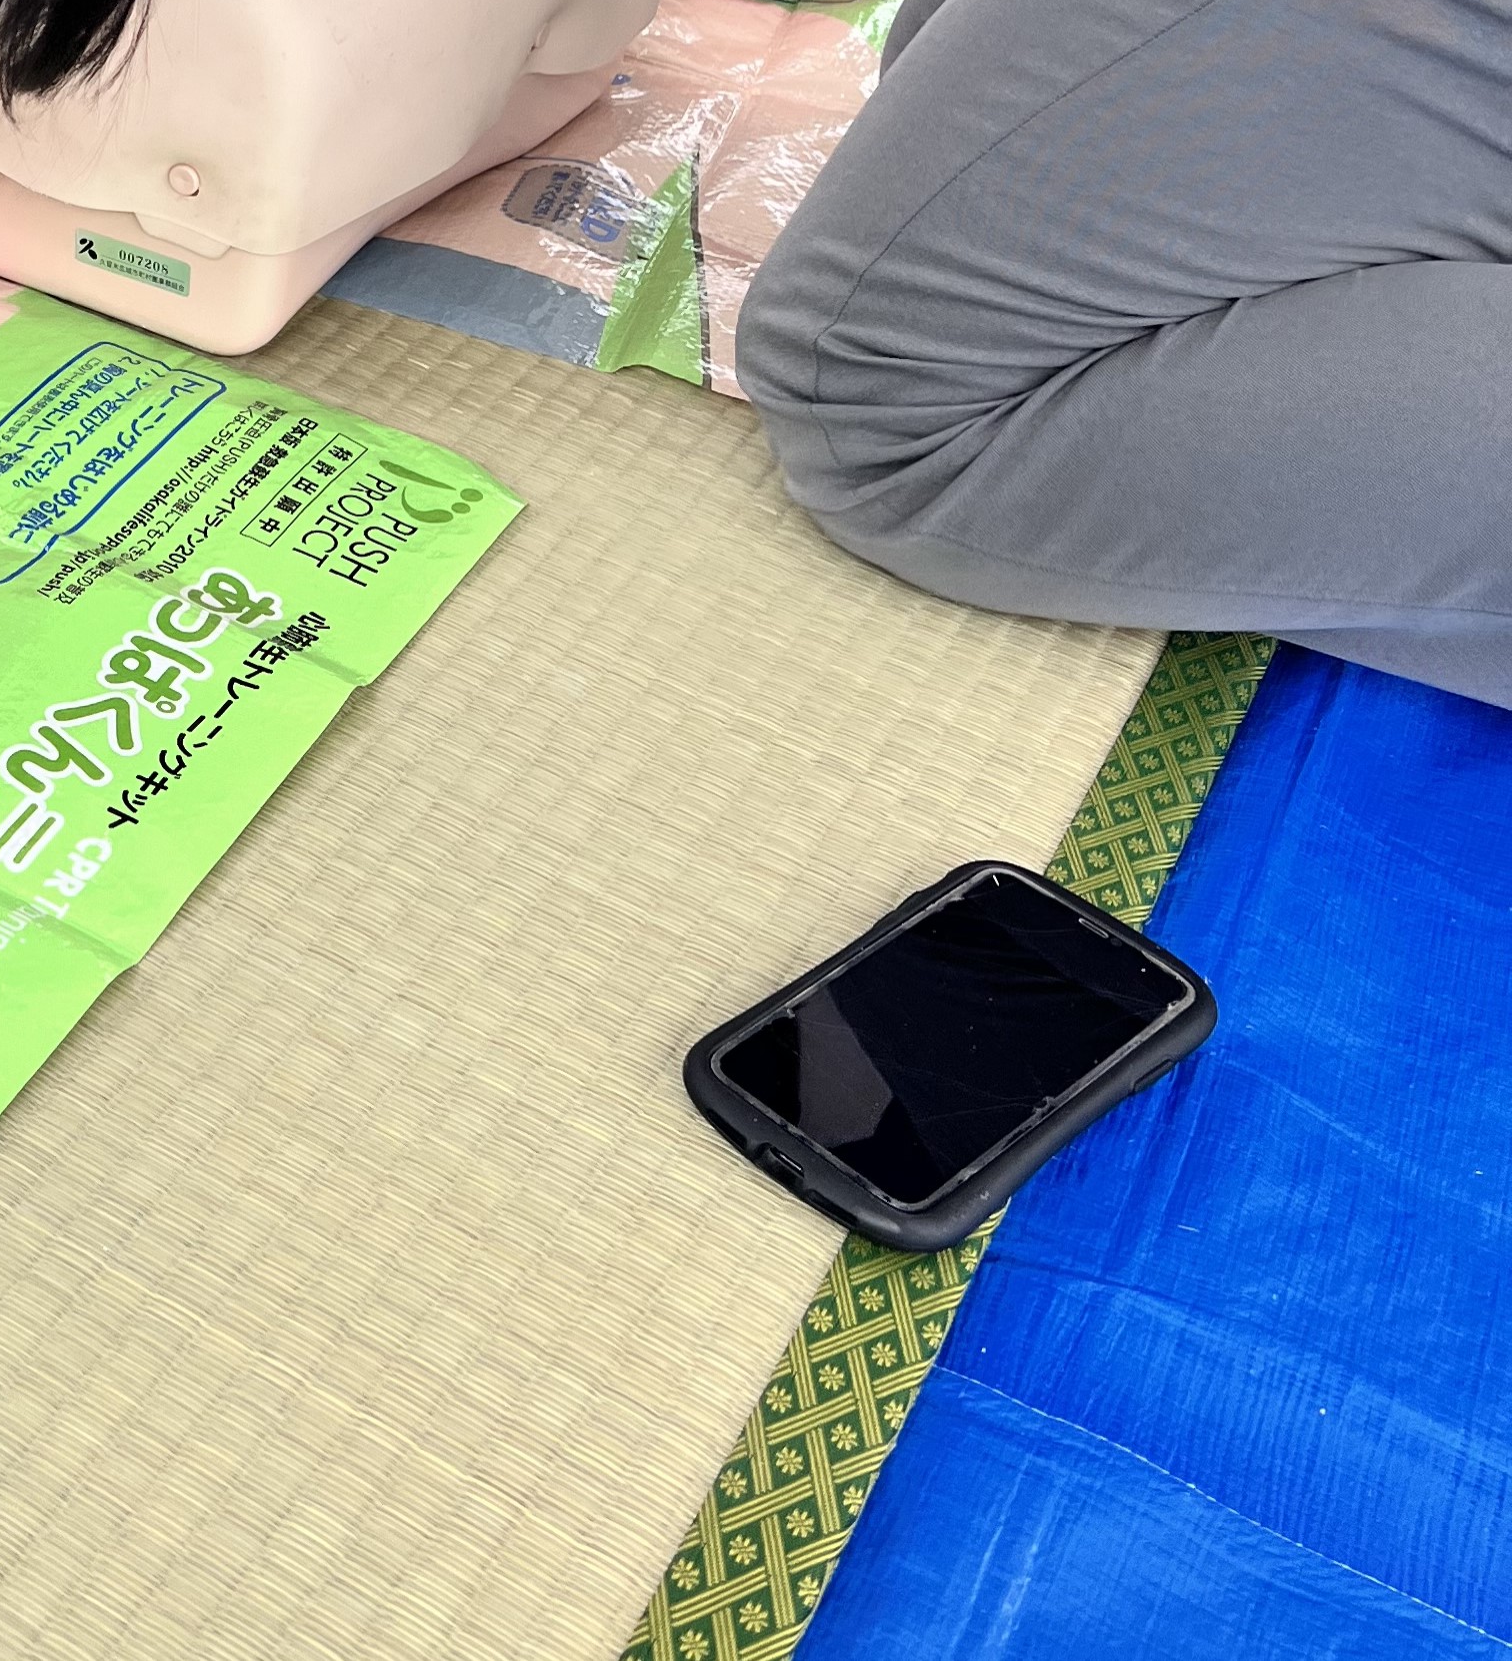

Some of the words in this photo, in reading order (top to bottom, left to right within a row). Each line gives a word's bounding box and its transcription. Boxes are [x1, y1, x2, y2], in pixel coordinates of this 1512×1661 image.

[119, 250, 169, 275] 007208
[7, 373, 204, 547] トレーニングをはじめる前に
[291, 467, 396, 569] PROJECT
[328, 512, 418, 588] PUSH
[42, 837, 114, 897] CPR
